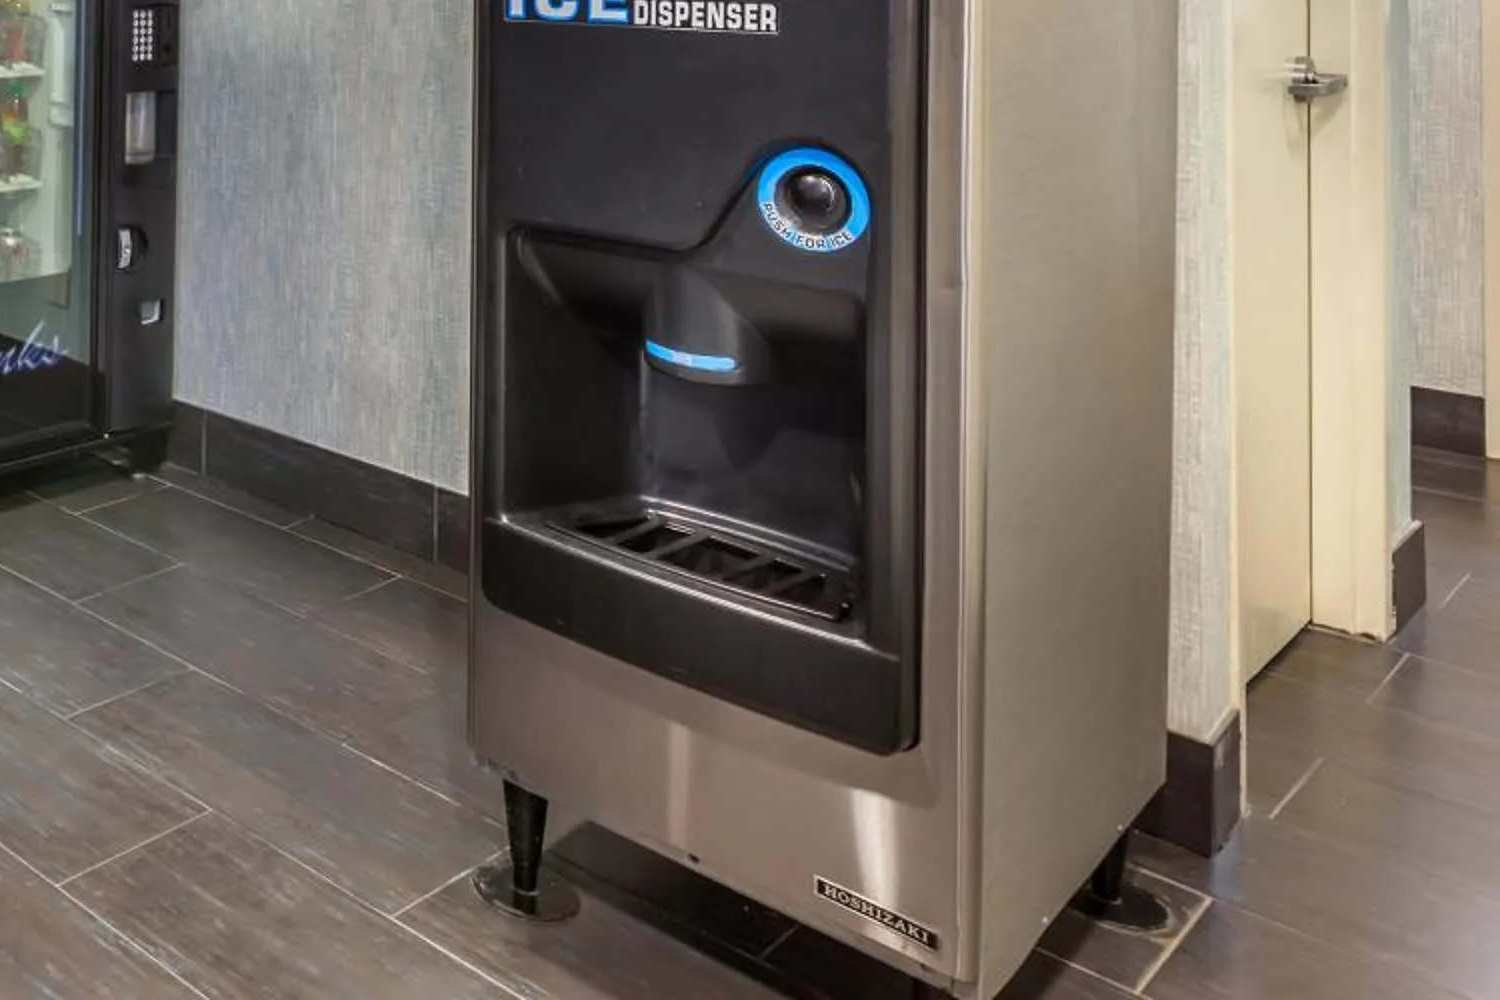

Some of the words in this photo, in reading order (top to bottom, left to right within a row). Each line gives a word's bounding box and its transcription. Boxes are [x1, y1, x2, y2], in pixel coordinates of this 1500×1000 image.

[633, 0, 778, 32] DISPENSER
[762, 202, 792, 239] PUSH
[795, 234, 826, 249] FOR
[828, 231, 853, 248] ICE
[823, 882, 931, 945] HOSHIZAKI
